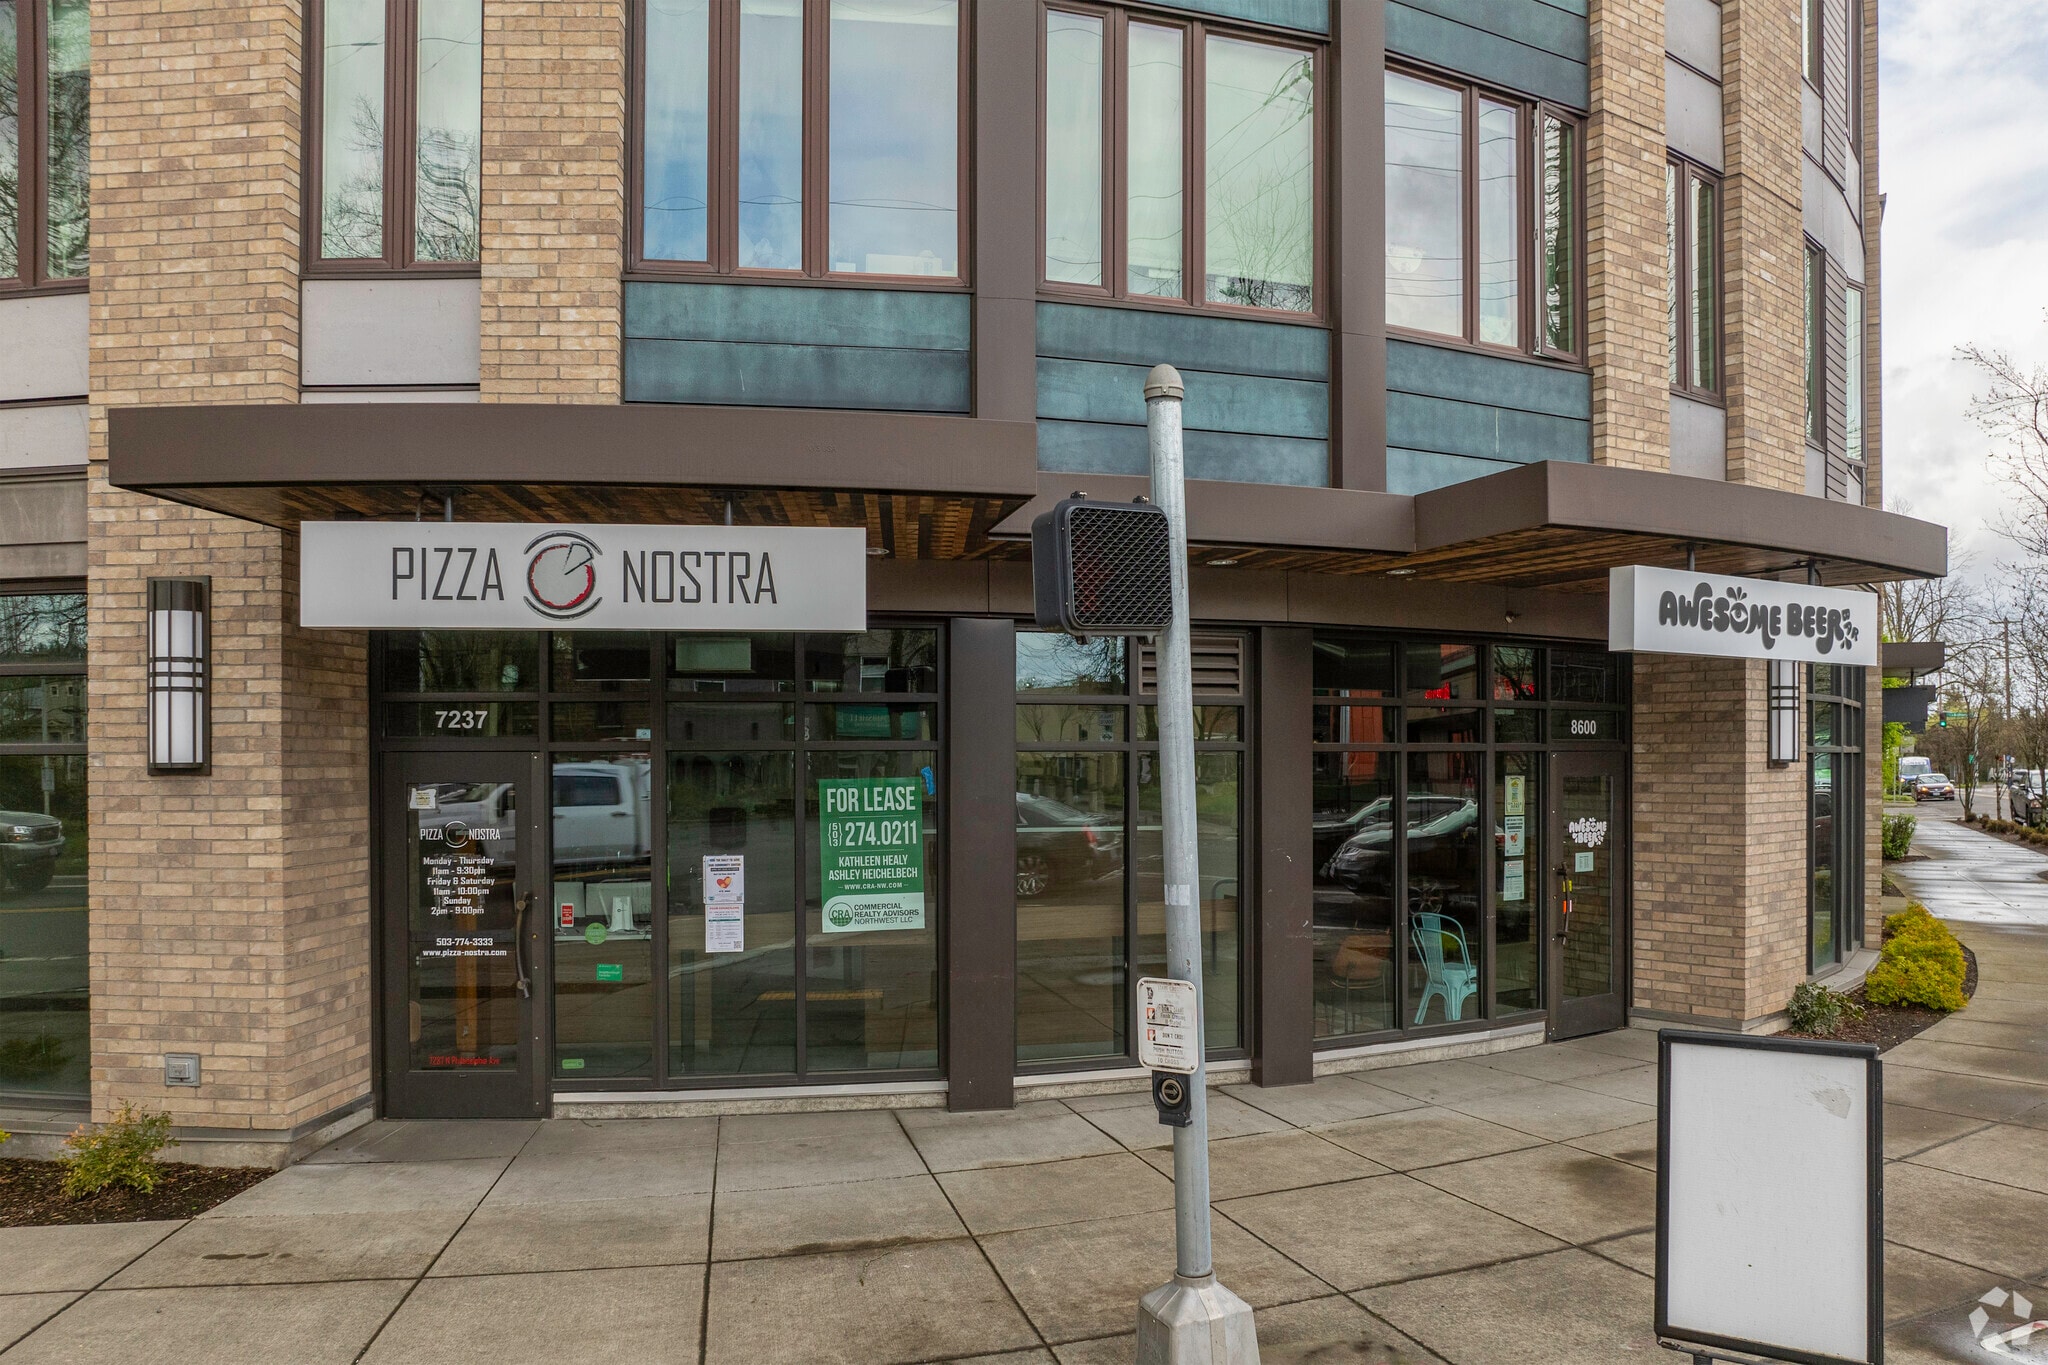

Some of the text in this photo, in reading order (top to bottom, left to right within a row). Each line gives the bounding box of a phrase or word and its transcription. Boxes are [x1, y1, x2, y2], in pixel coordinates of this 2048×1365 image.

[392, 547, 778, 604] PIZZA NOSTRA
[1659, 582, 1781, 650] AWESOME
[1786, 603, 1844, 654] BEER
[434, 710, 489, 729] 7237
[1570, 719, 1597, 735] 8600
[826, 786, 916, 813] FOR LEASE
[1568, 817, 1607, 836] AWESOME
[420, 828, 501, 841] PIZZA NOSTRA
[845, 820, 917, 847] 274.0211
[423, 857, 452, 866] Monday
[459, 856, 495, 865] Thursday
[838, 854, 909, 868] KATHLEEN HEALY
[456, 866, 486, 876] 9:30pm
[828, 867, 919, 881] ASHLEY HEICHELBECH
[427, 877, 452, 887] Friday
[460, 877, 496, 886] Saturday
[844, 882, 903, 890] WWW.CRA-NW.COM
[457, 887, 490, 896] 10:00pm
[443, 896, 472, 906] Sunday
[430, 906, 448, 916] 2pm
[455, 906, 485, 916] 9:00pm
[853, 902, 903, 911] COMMERCIAL
[831, 909, 851, 920] CRA
[883, 909, 920, 917] ADVISORS
[854, 917, 899, 925] NORTHWEST
[435, 937, 494, 947] 503-774-3333
[422, 948, 508, 958] www.pizza-nostra.com
